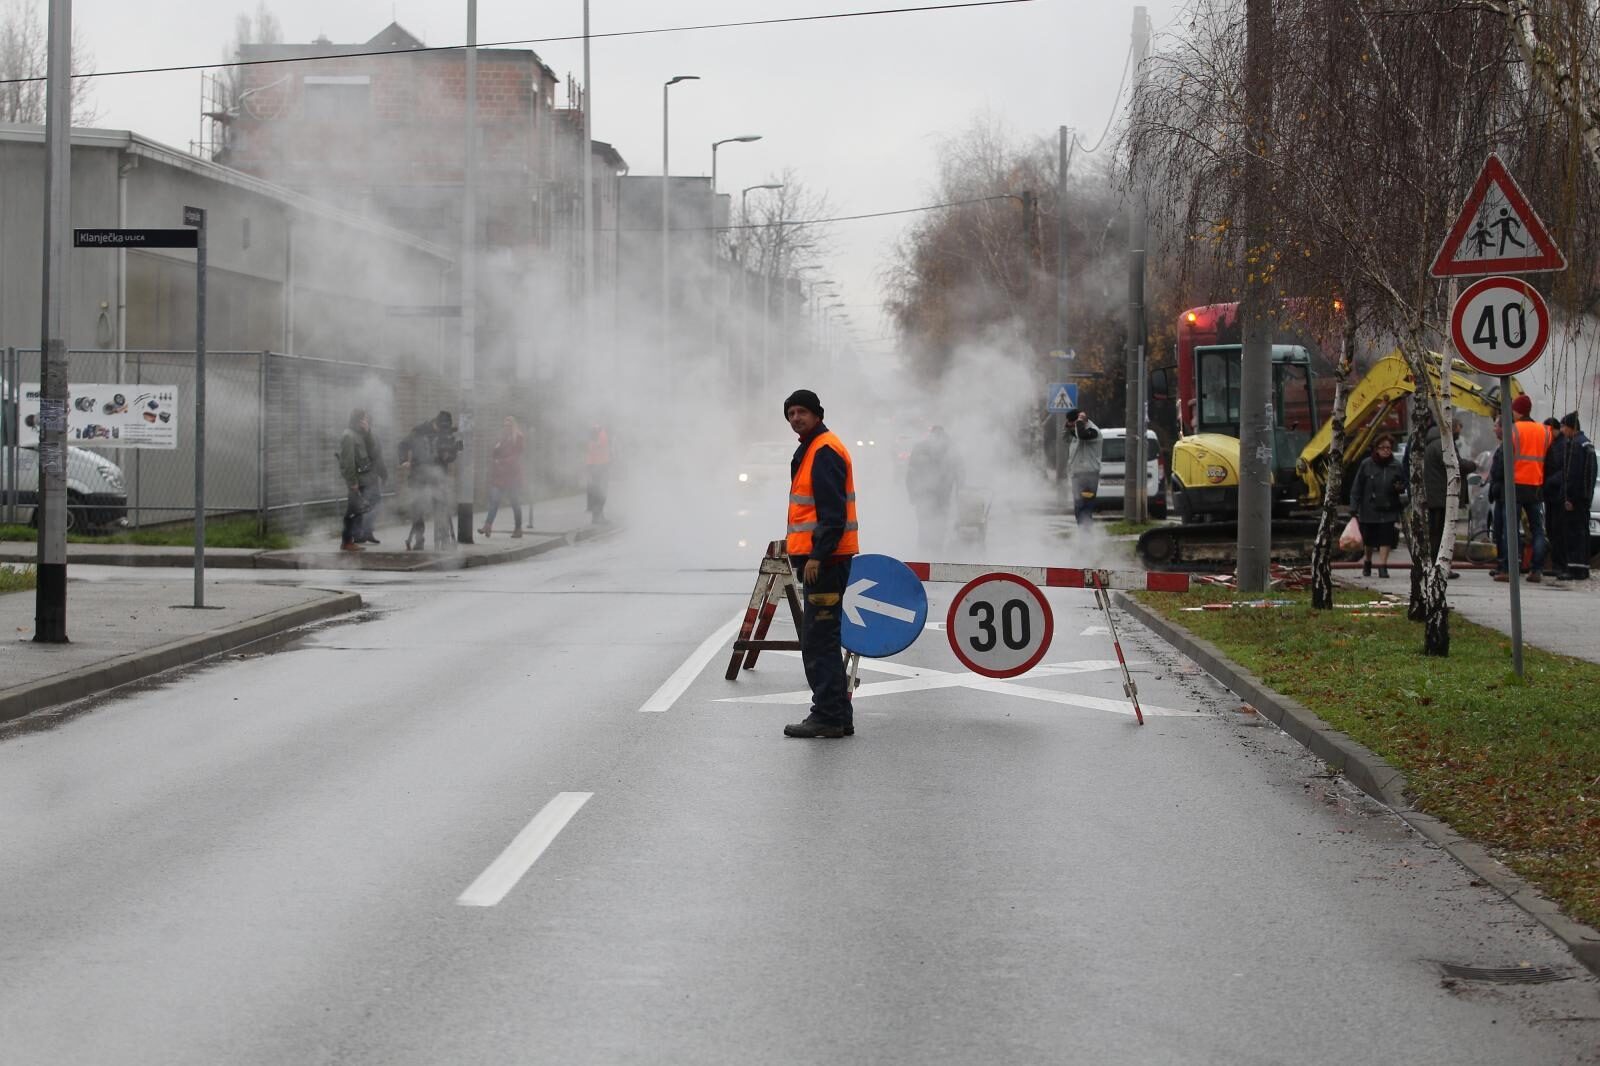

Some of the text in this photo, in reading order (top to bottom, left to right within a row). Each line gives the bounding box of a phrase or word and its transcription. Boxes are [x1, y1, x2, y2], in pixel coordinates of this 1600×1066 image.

[80, 232, 124, 244] Klanječka
[1472, 302, 1527, 350] 40
[969, 598, 1031, 652] 30
